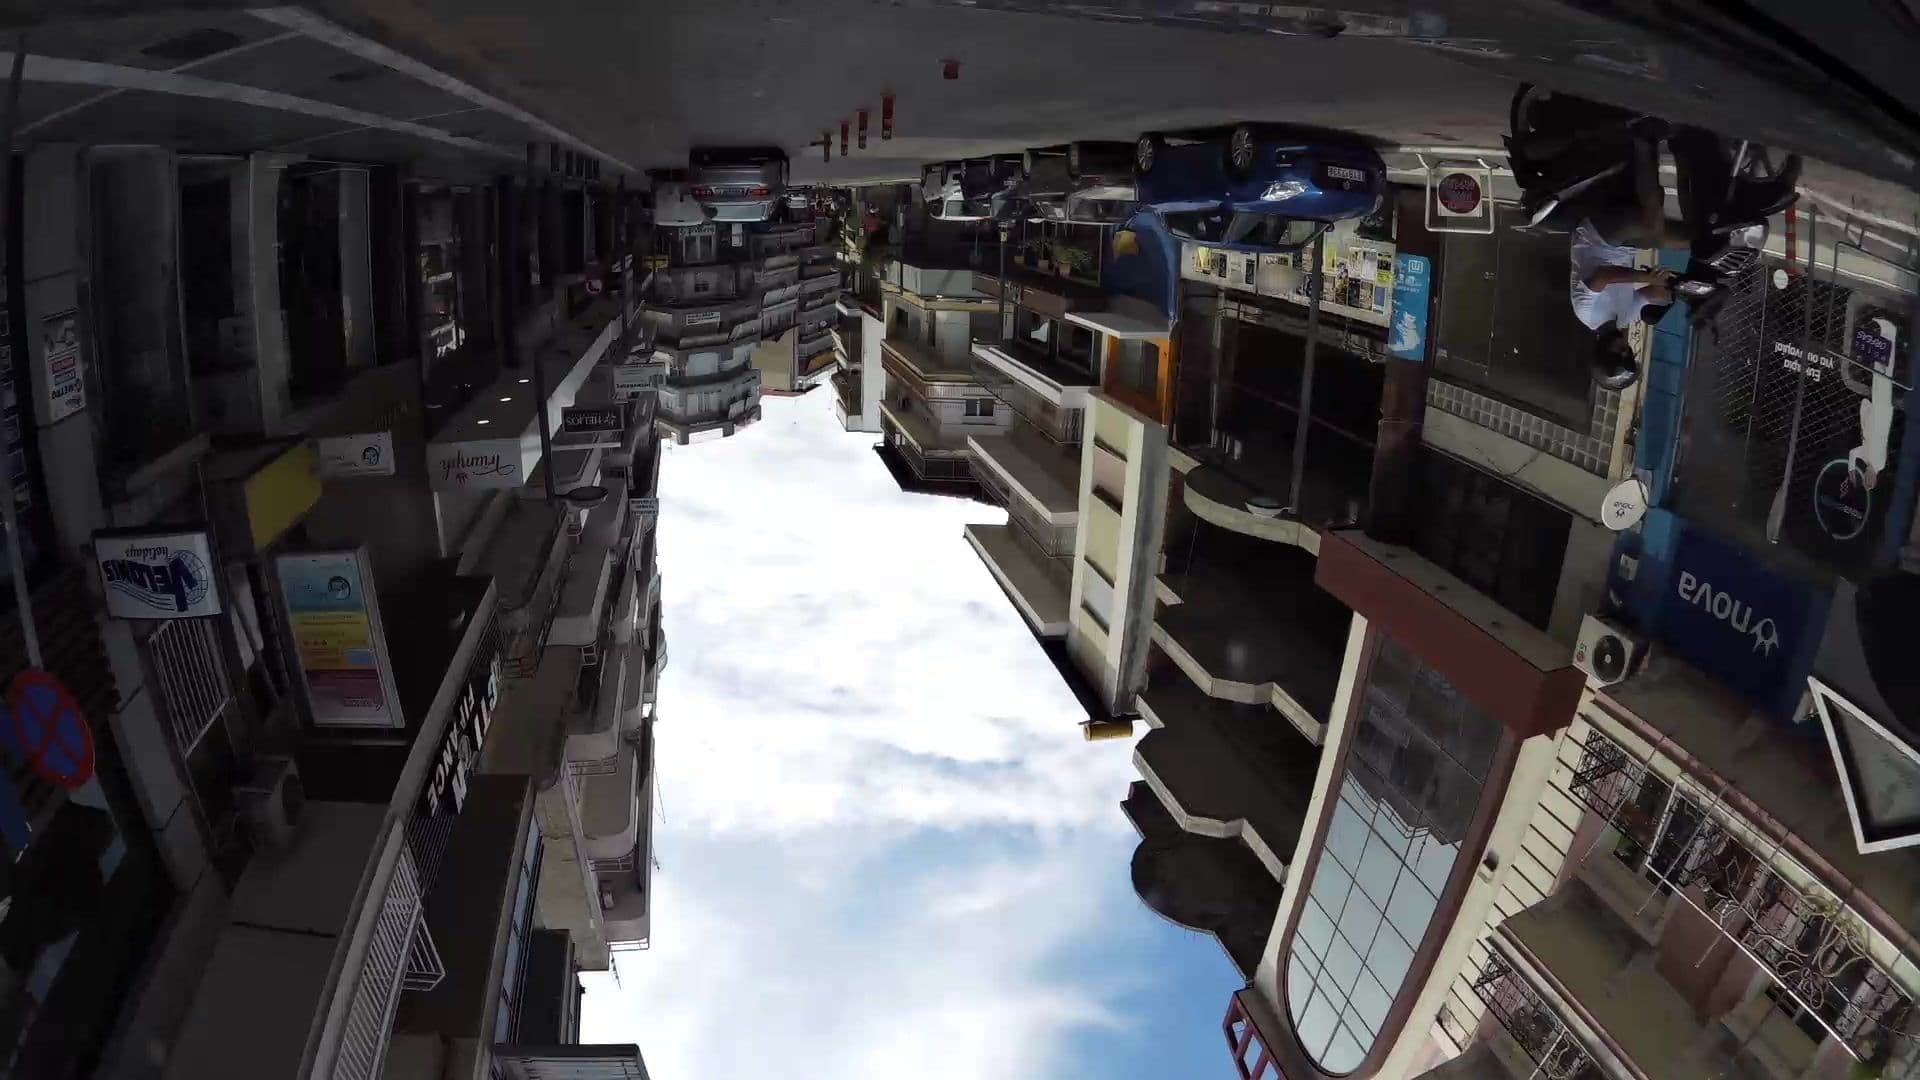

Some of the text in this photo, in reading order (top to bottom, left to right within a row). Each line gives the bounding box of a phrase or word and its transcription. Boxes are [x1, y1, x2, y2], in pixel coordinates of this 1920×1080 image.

[440, 450, 516, 477] Triumph
[124, 544, 169, 561] holidays
[1677, 570, 1753, 633] nova
[427, 682, 475, 817] FINANCE
